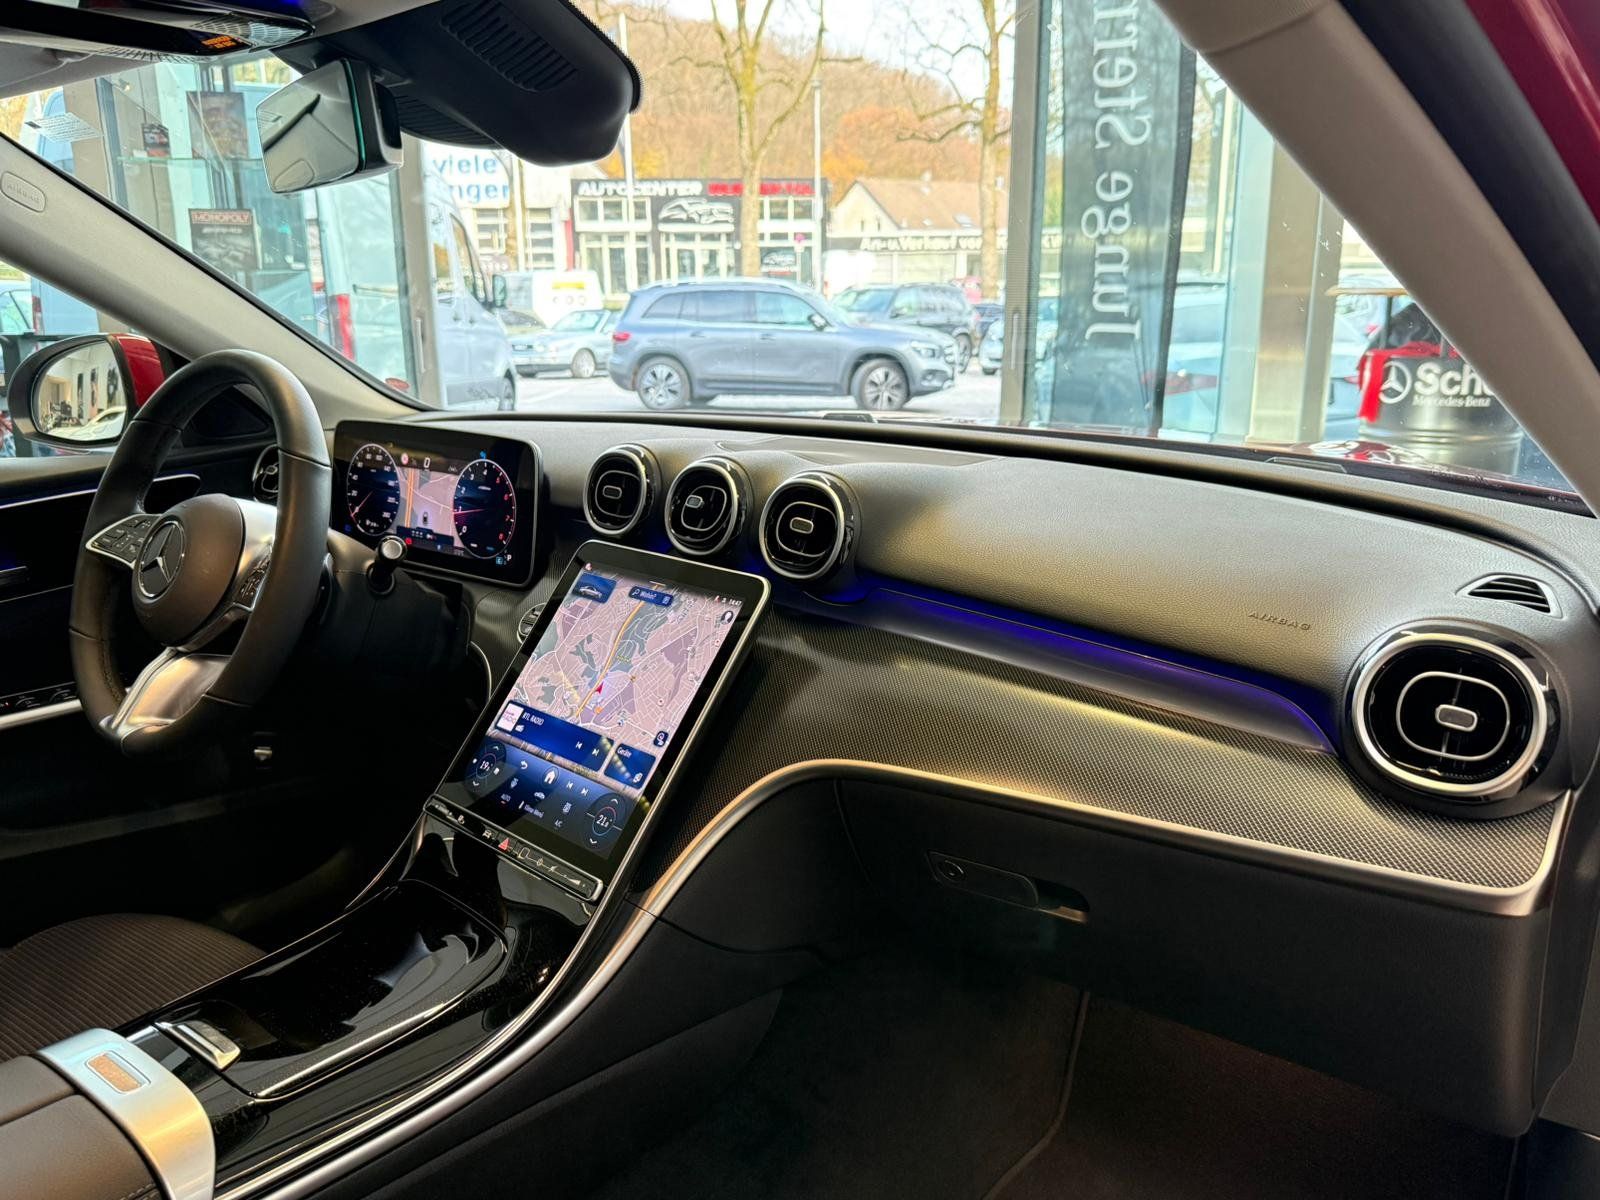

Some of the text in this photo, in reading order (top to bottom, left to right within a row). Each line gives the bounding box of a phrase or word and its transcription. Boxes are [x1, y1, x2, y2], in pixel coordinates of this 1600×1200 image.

[192, 211, 250, 225] MONOPOLY
[424, 456, 431, 469] 0
[1248, 612, 1311, 631] AIRBAG
